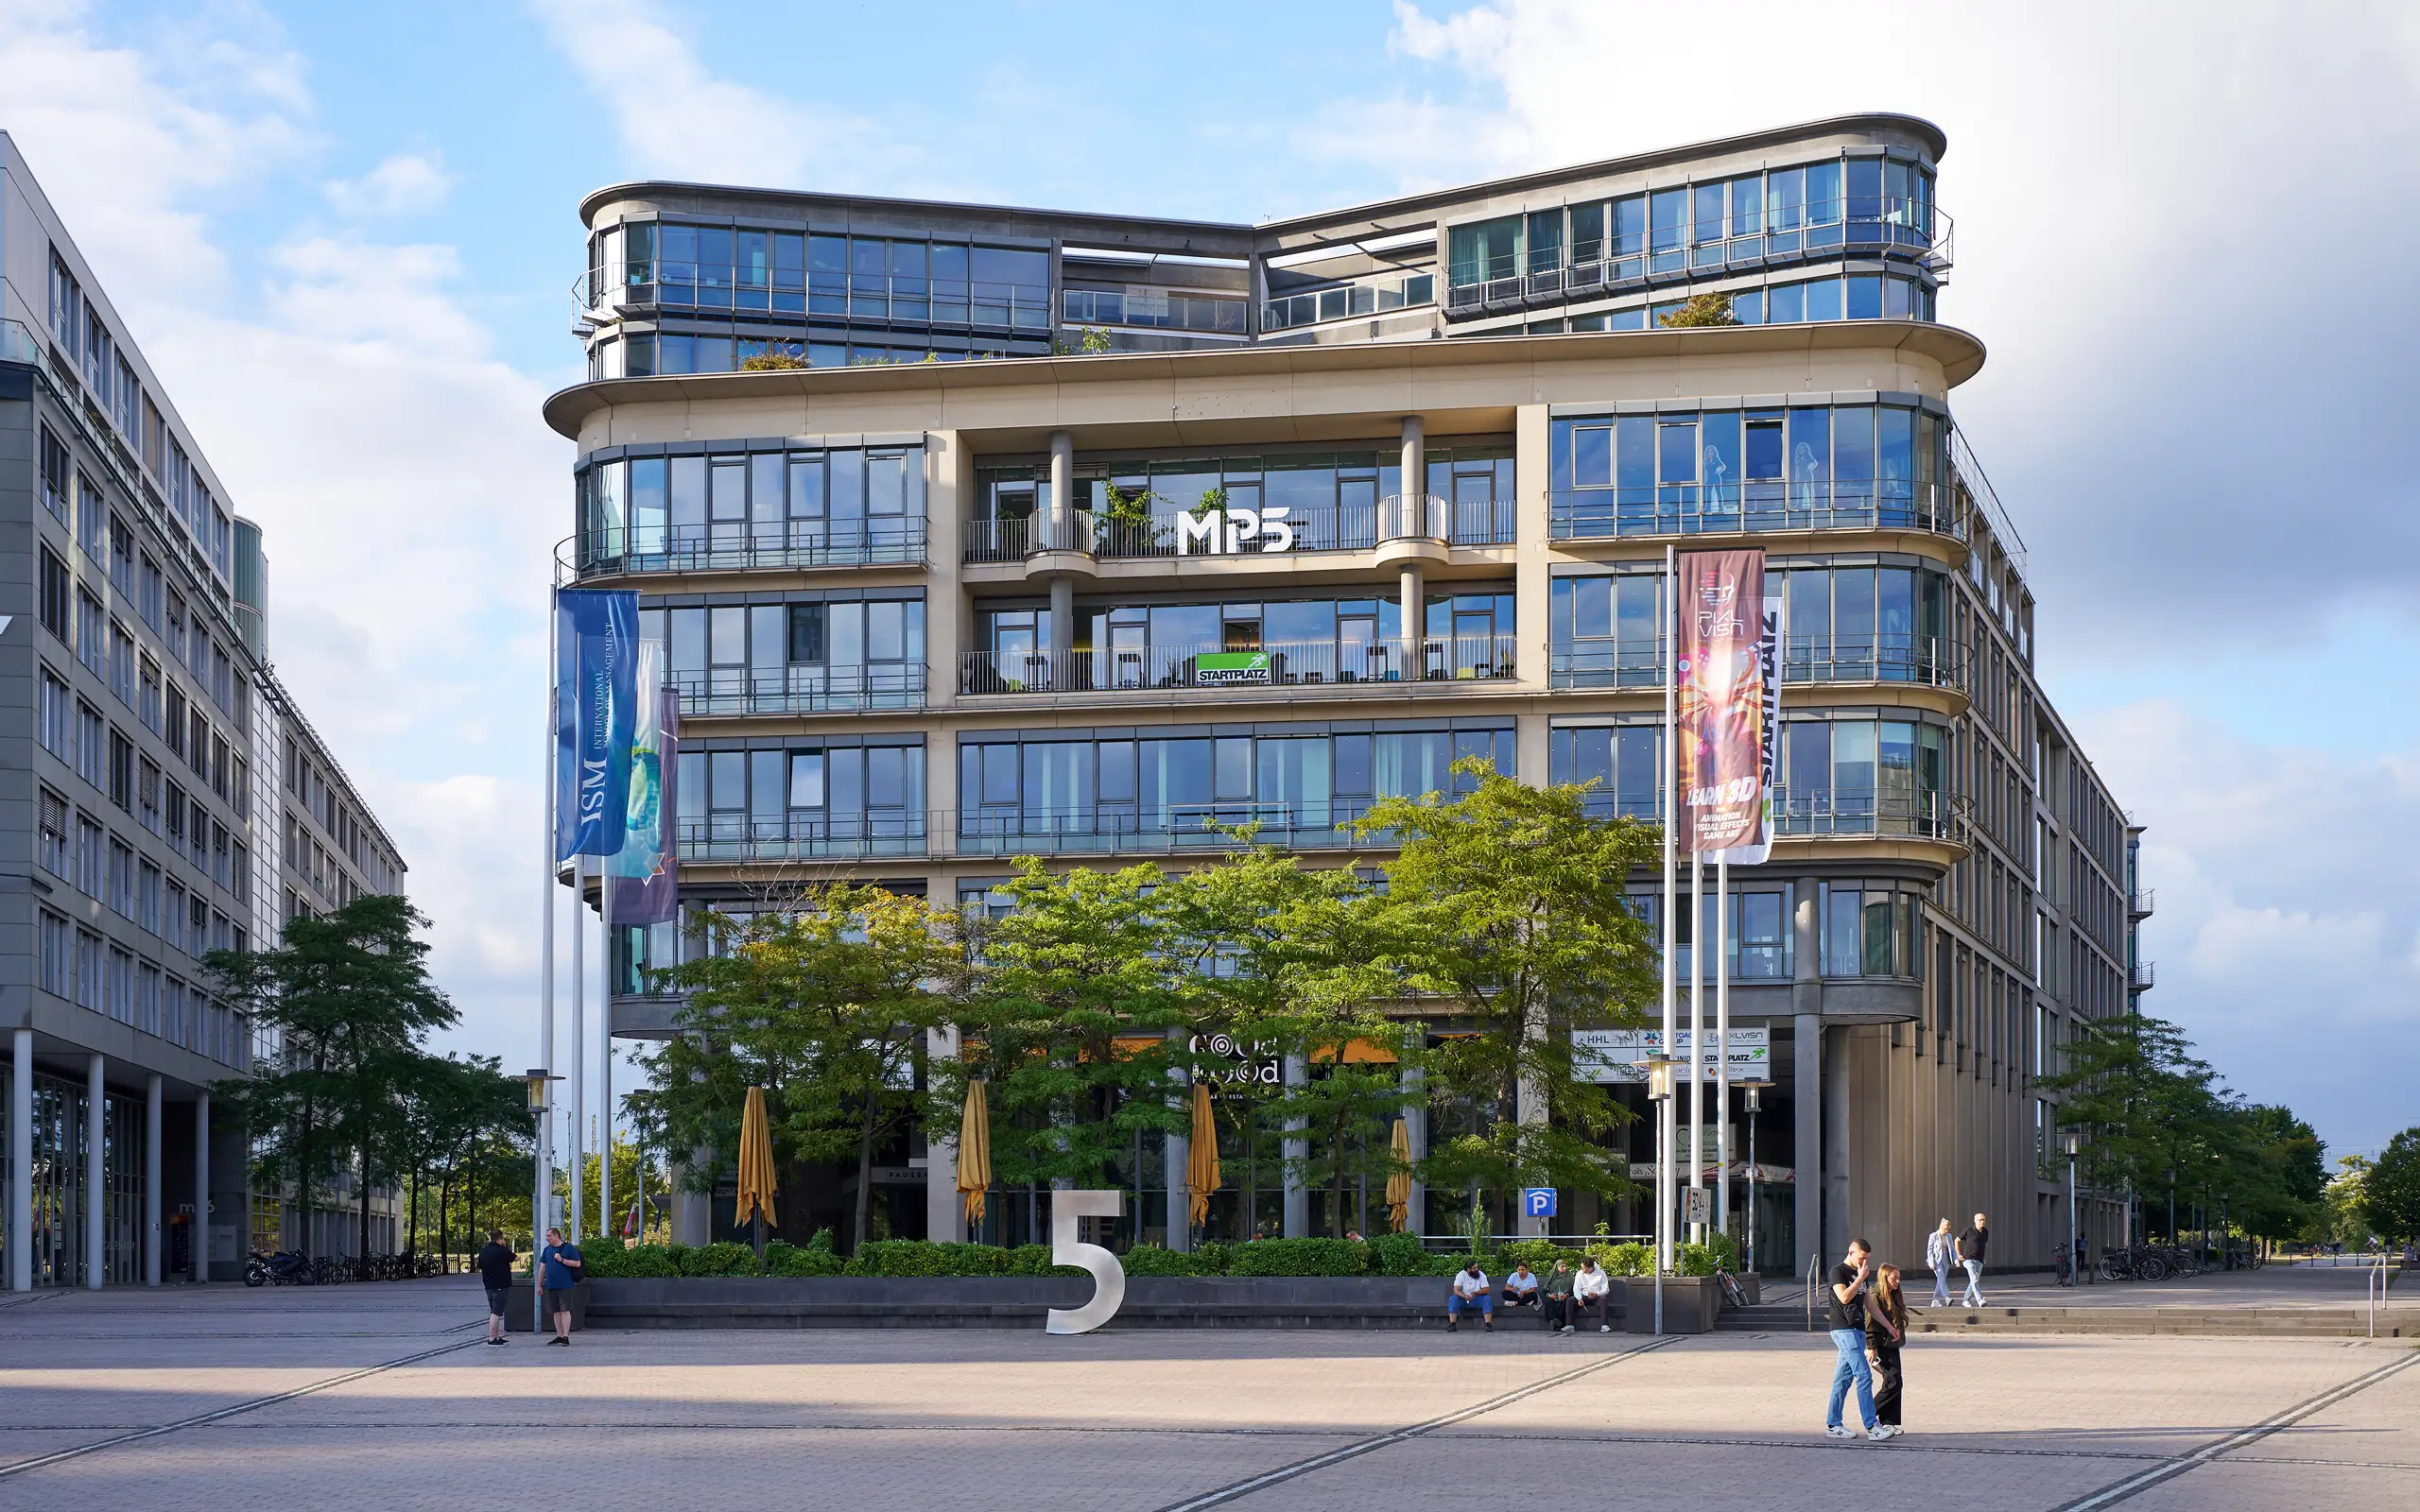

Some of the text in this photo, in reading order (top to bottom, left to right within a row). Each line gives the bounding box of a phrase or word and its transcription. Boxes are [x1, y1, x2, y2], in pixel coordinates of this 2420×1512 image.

[1177, 507, 1293, 556] MP5
[1199, 667, 1268, 681] STARTPLATZ
[594, 670, 604, 749] INTERNATIONAL
[580, 757, 608, 827] ISM
[1686, 776, 1757, 806] LEARN 3D
[1694, 818, 1751, 832] VISUAL EFFECTS
[1701, 811, 1741, 823] ANIMATION
[1703, 830, 1740, 840] GAME ART
[1587, 1035, 1610, 1044] HHL
[1532, 1195, 1547, 1214] P
[1046, 1190, 1126, 1335] 5
